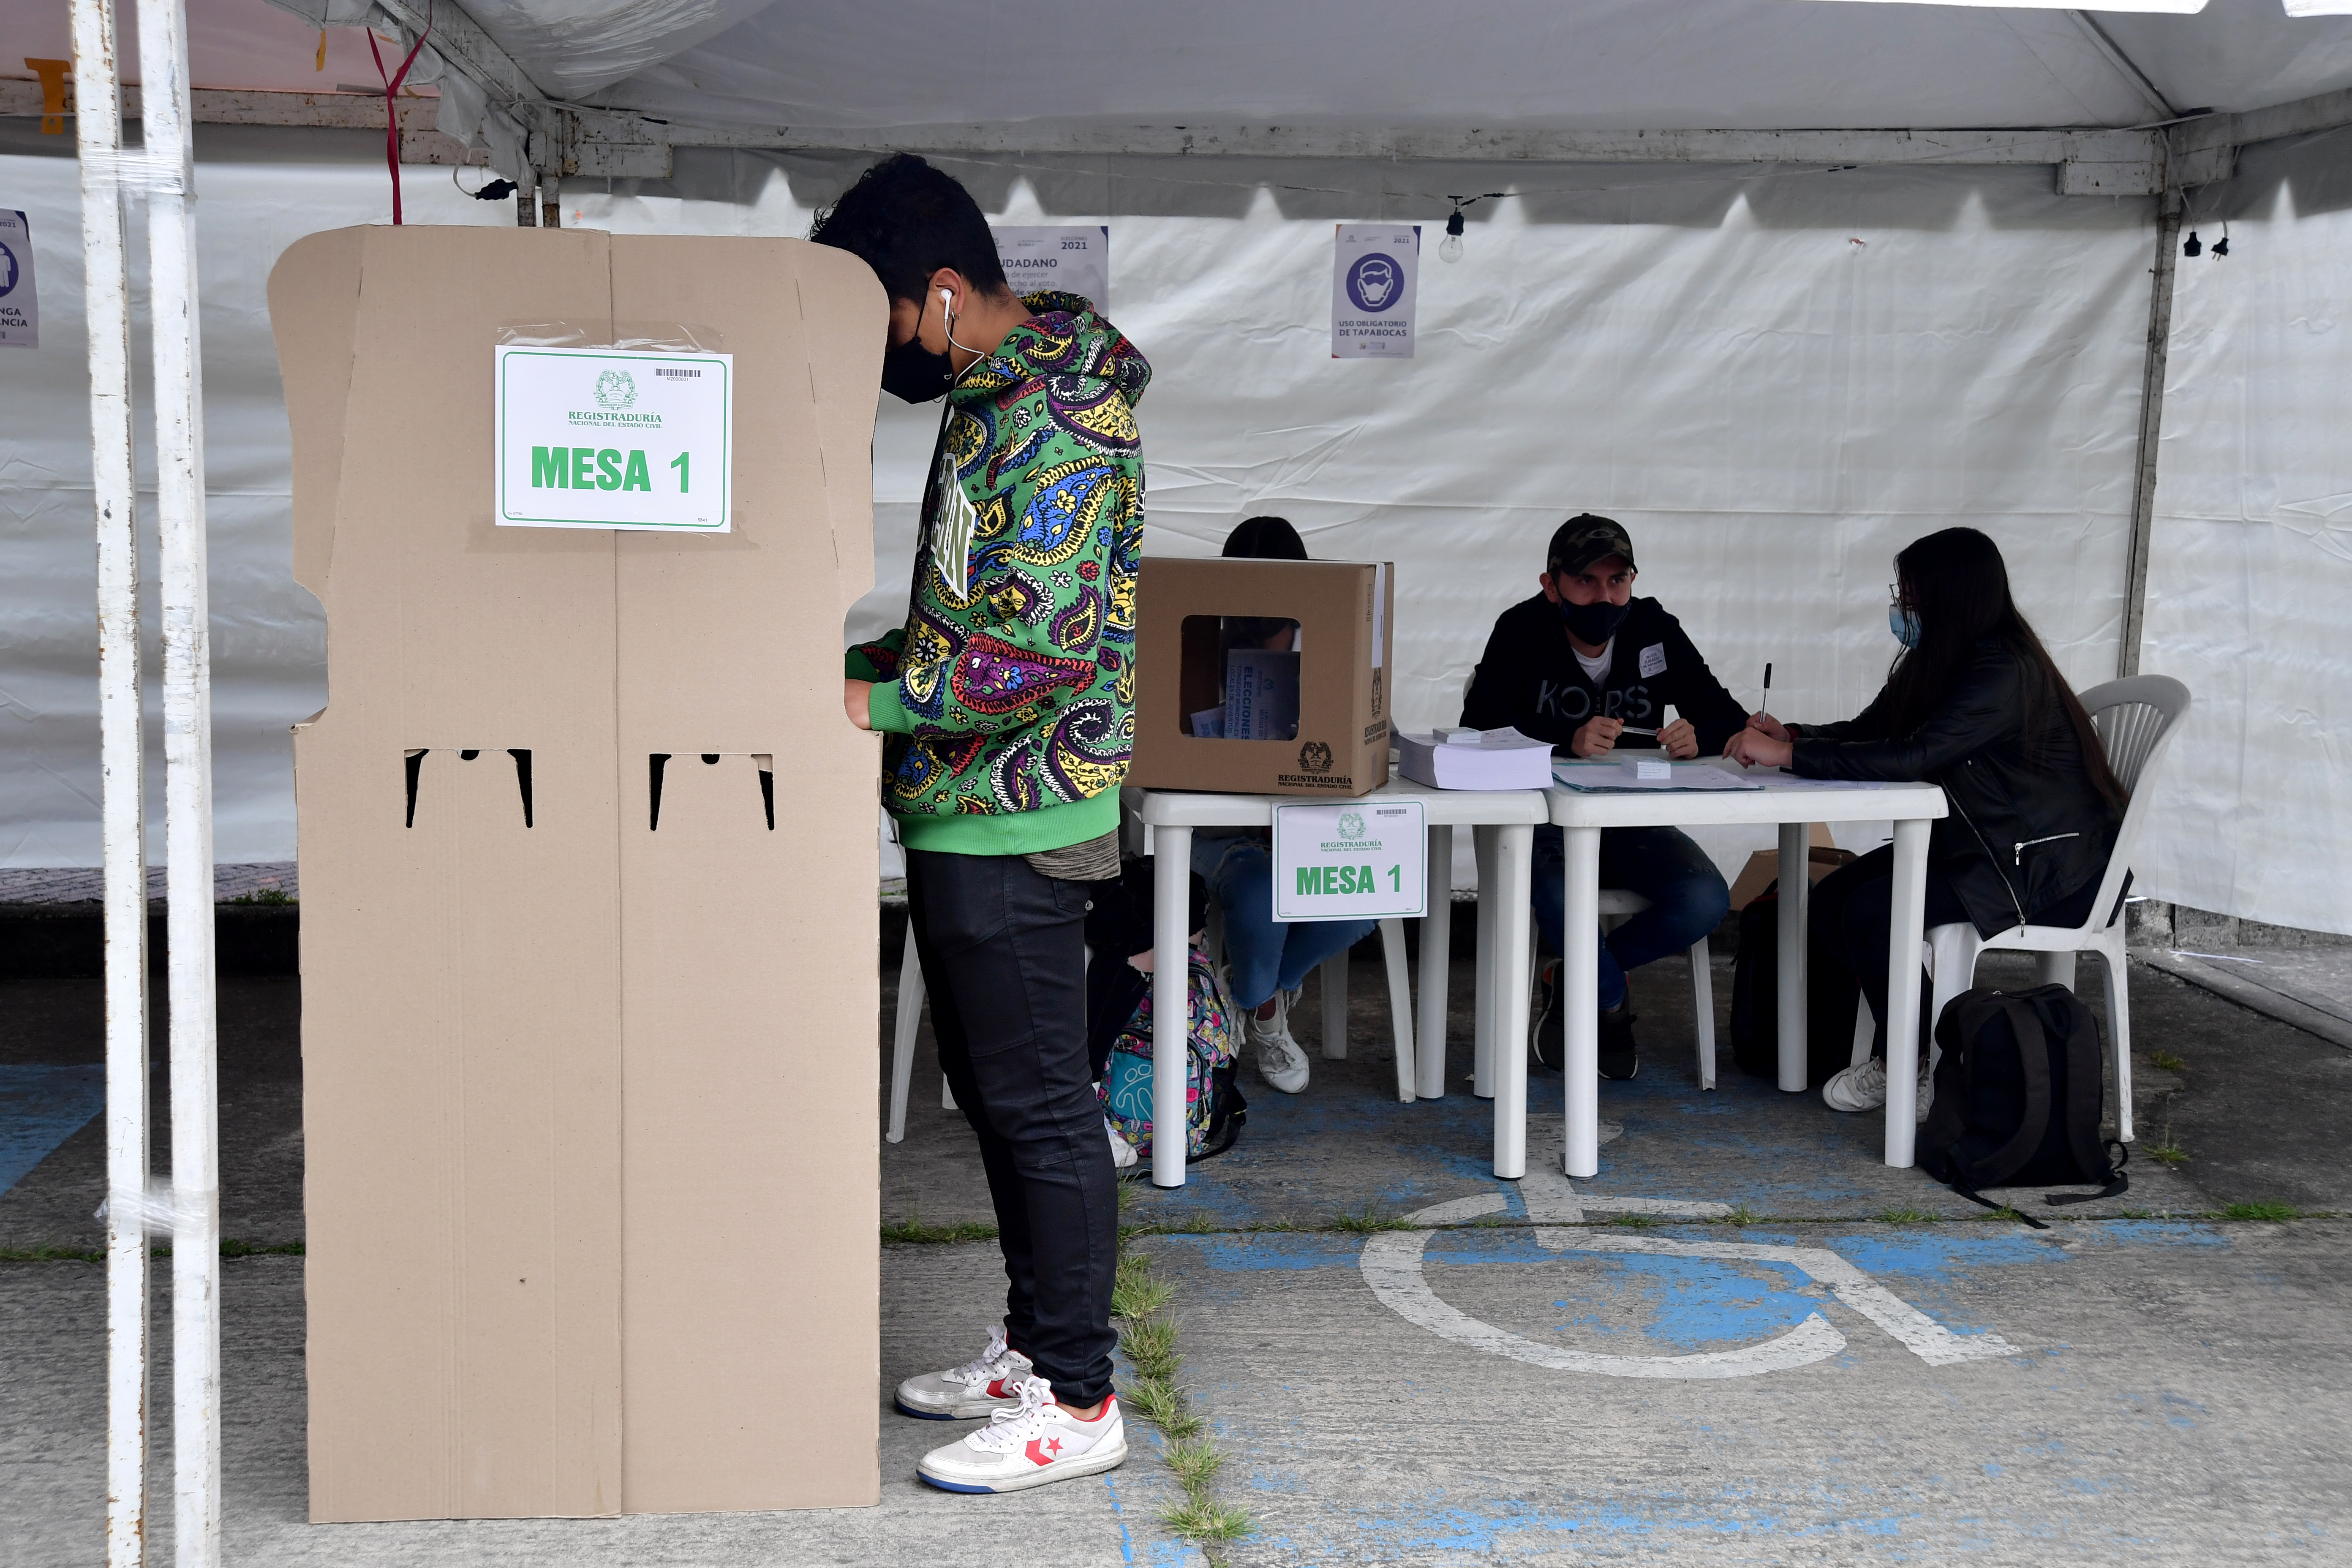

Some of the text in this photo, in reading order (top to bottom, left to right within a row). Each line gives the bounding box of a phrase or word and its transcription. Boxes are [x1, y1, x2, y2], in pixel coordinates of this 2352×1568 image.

[568, 411, 662, 422] REGISTRADURÍA
[532, 446, 689, 493] MESA 1
[1278, 774, 1352, 784] REGISTRADURÍA
[1320, 839, 1382, 848] REGISTRADURÍA
[1296, 864, 1400, 895] MESA 1
[1083, 1462, 1113, 1472] CONVERSE
